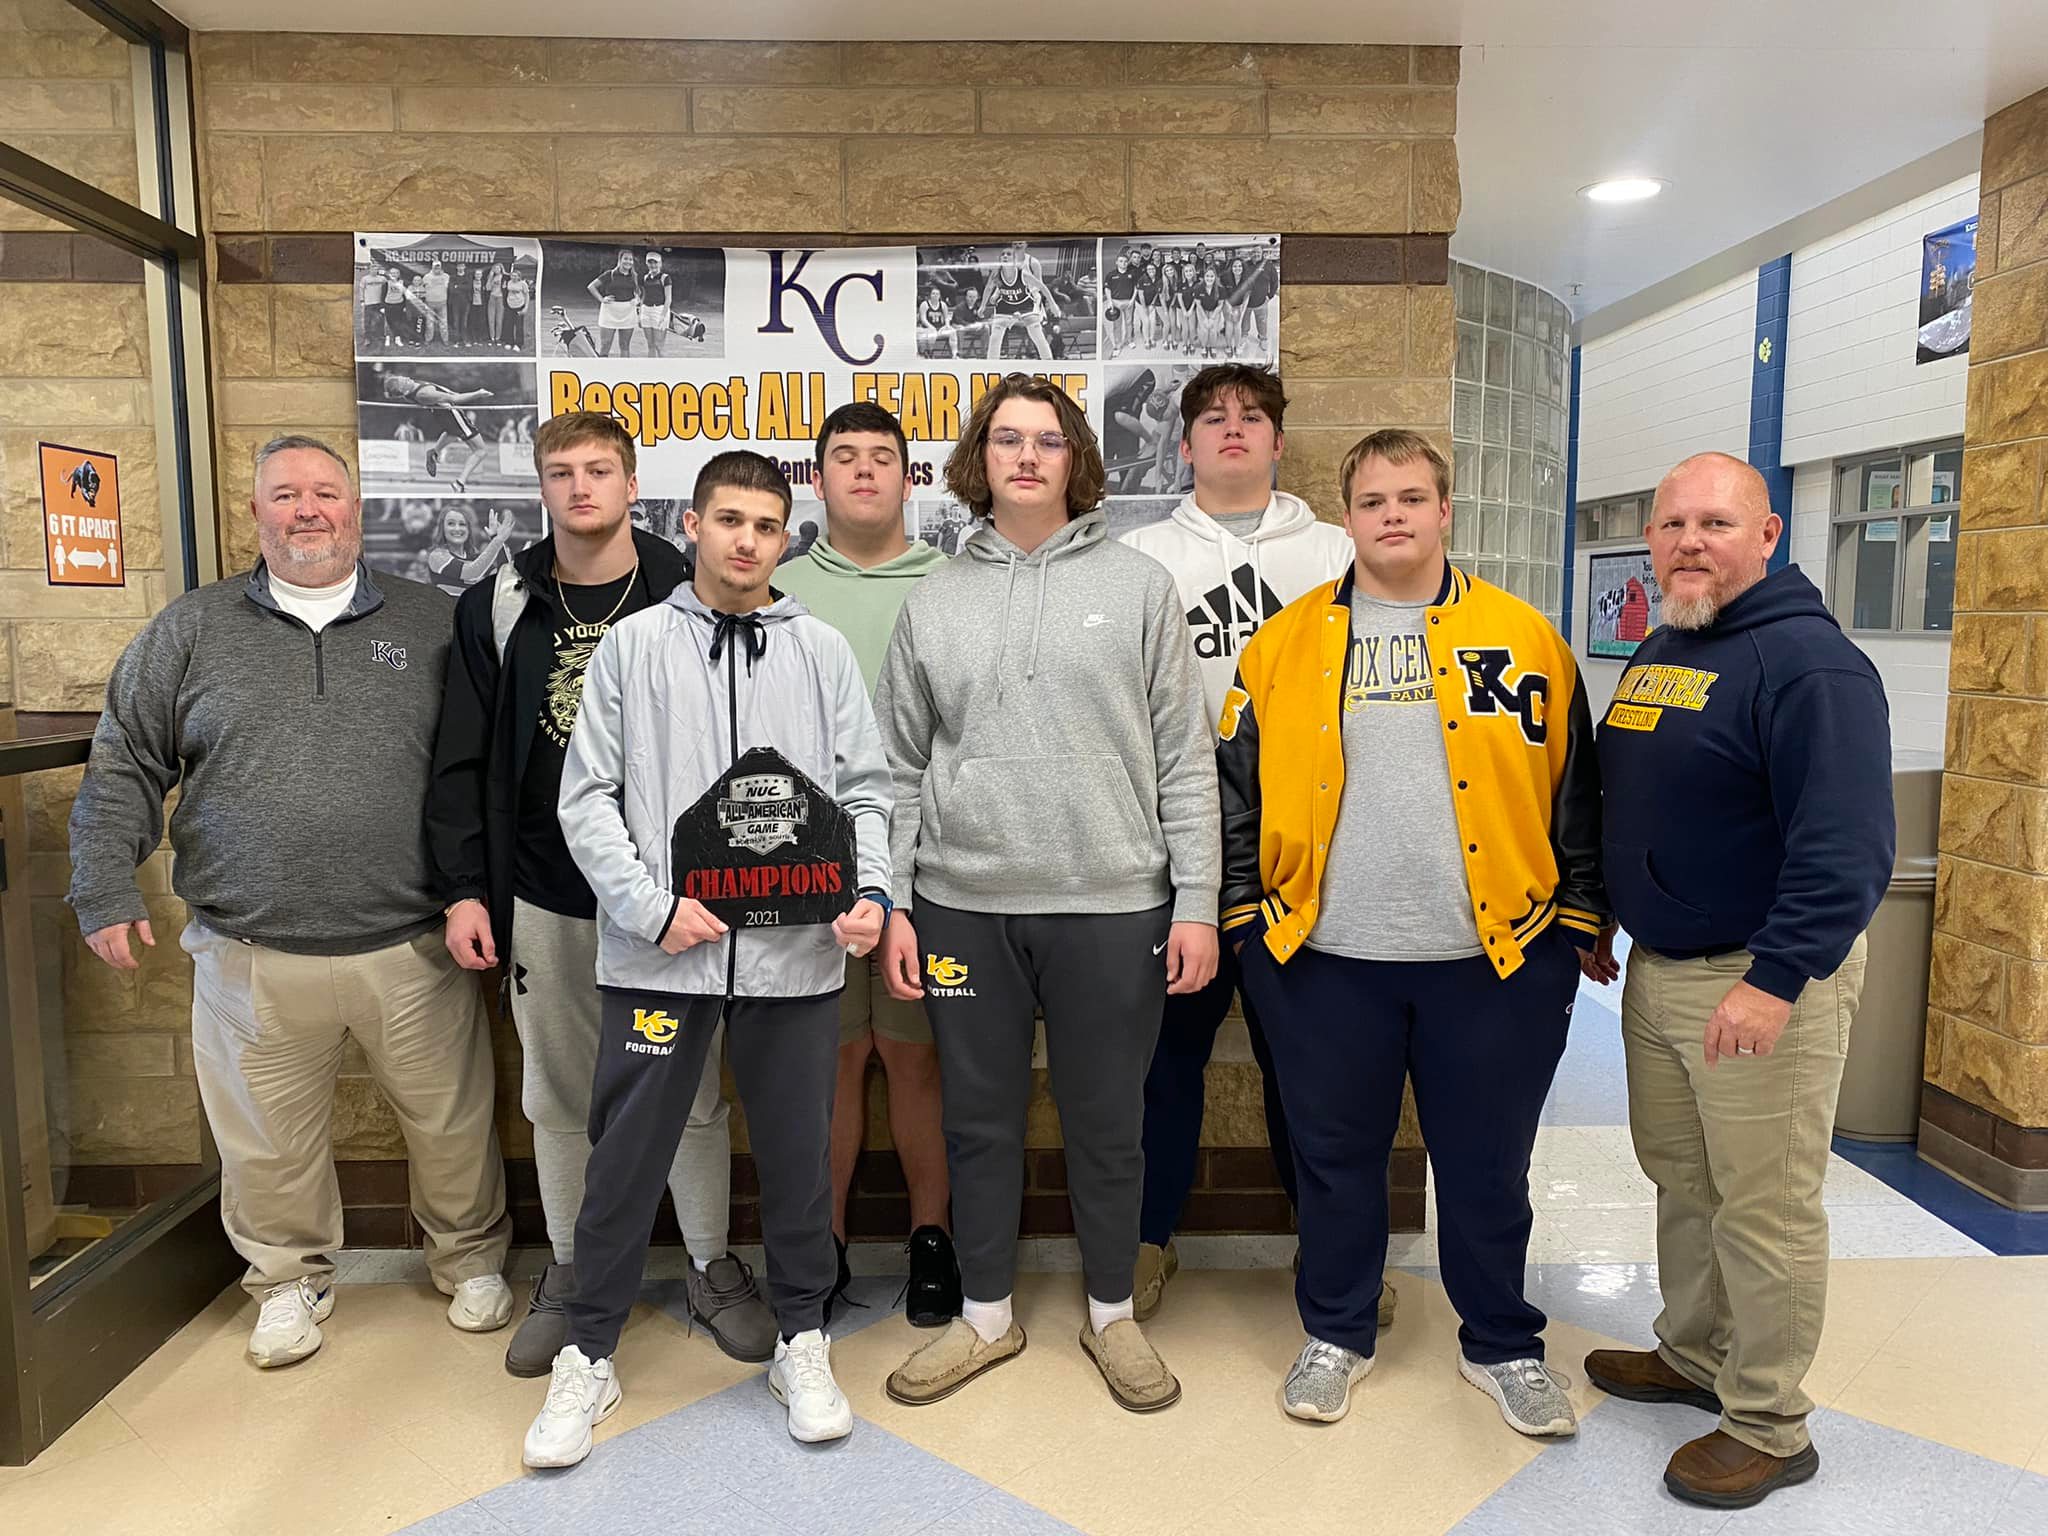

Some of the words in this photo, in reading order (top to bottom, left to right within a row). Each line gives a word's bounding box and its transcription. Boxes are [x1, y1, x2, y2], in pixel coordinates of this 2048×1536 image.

[401, 250, 440, 263] CROSS
[441, 250, 497, 264] COUNTRY
[756, 249, 885, 367] KC
[550, 371, 749, 447] Respect
[756, 372, 826, 440] ALL
[49, 513, 60, 535] 6
[61, 514, 76, 537] FT
[79, 515, 117, 540] APART
[371, 639, 408, 671] KC
[1453, 646, 1549, 747] KC
[745, 785, 781, 797] NUC
[747, 823, 779, 834] GAME
[685, 862, 842, 899] CHAMPIONS
[745, 910, 781, 926] 2021
